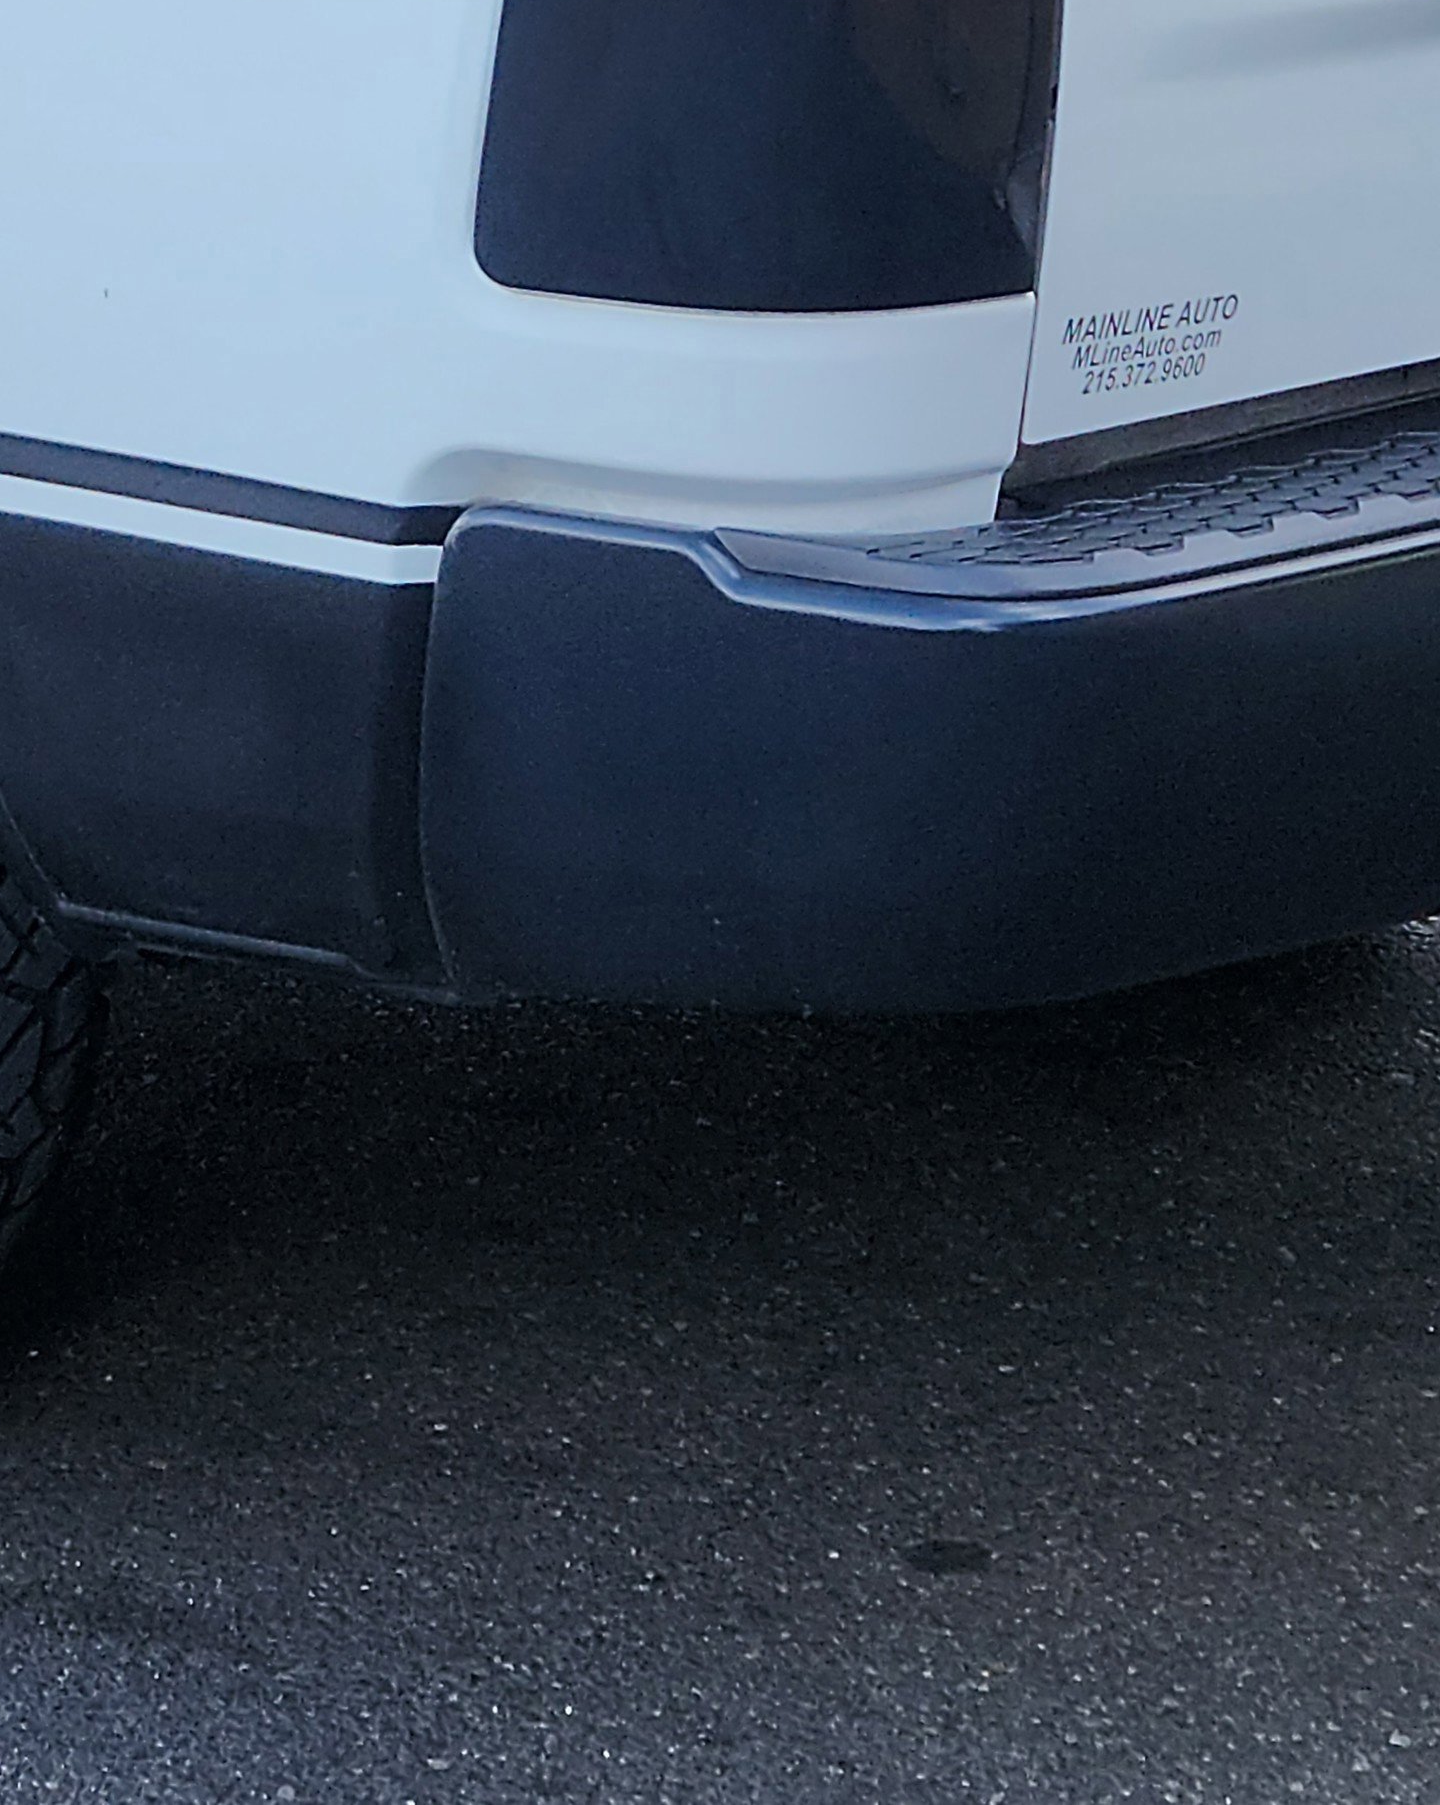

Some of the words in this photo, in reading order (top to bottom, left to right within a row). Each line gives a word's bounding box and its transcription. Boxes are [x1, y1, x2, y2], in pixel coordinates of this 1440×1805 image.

[1061, 303, 1174, 345] MAINLINE
[1175, 293, 1240, 327] AUTO
[1072, 328, 1222, 370] MLineAuto.com
[1081, 352, 1206, 395] 215.372.9600
